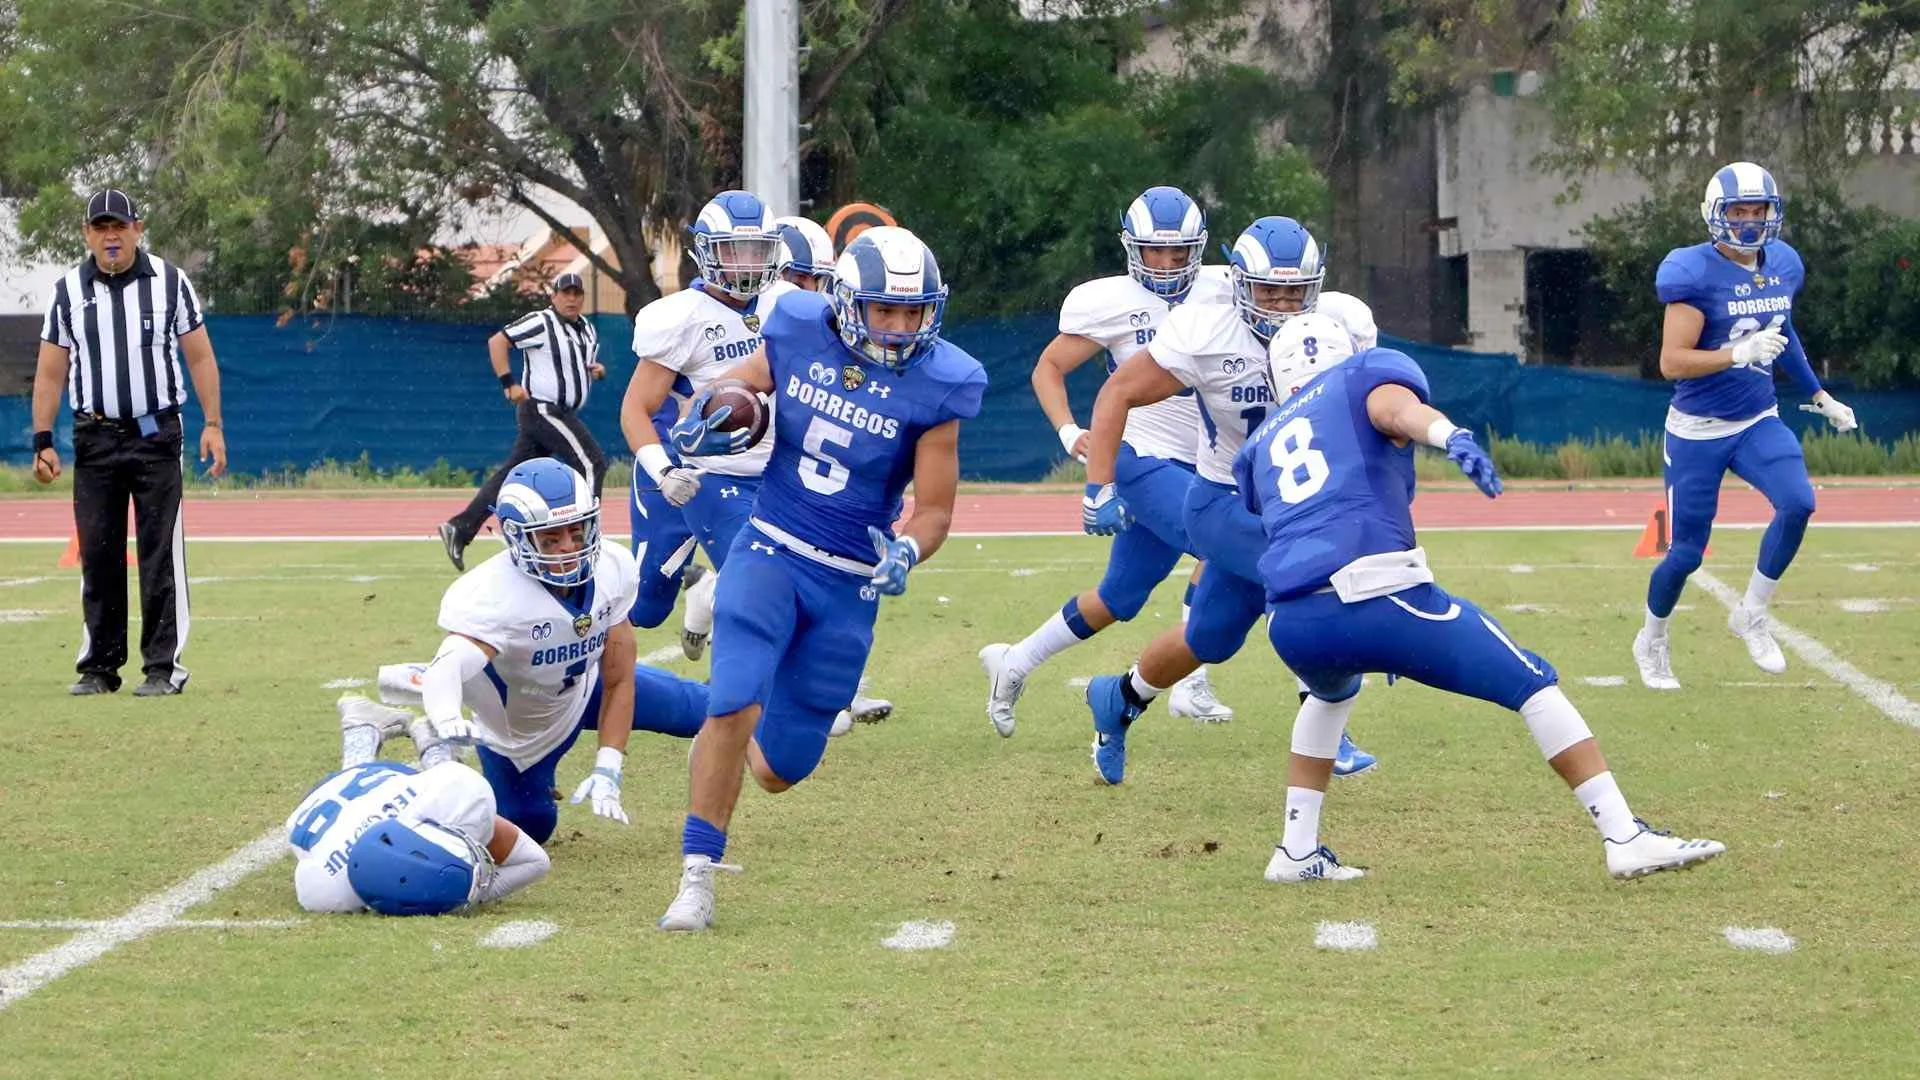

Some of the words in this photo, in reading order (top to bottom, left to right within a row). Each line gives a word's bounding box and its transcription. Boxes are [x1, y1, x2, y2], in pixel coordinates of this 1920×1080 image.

[890, 285, 919, 293] Riddell
[1727, 295, 1791, 315] BORREGOS
[143, 319, 151, 330] U
[1303, 336, 1319, 357] 8
[786, 374, 899, 439] BORREGOS
[797, 415, 853, 496] 5
[1269, 416, 1330, 504] 8
